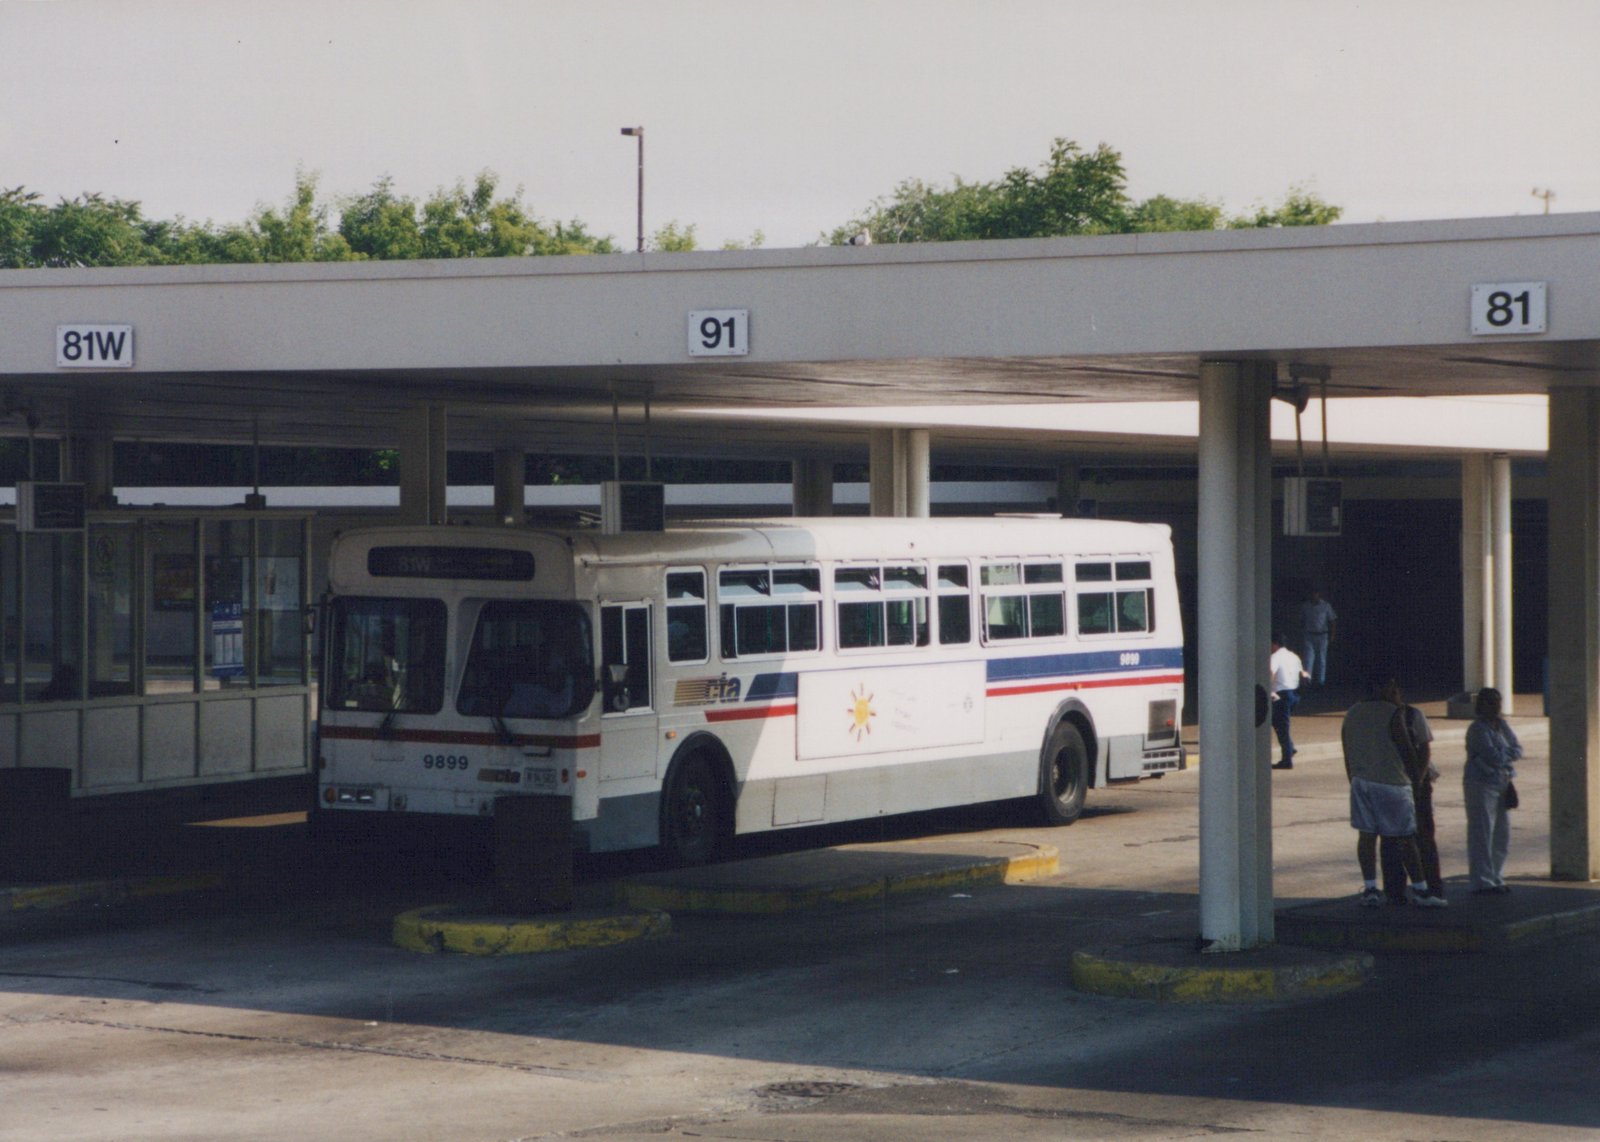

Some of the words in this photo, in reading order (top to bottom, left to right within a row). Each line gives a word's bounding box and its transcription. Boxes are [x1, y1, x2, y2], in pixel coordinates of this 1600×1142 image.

[1486, 291, 1530, 327] 81
[62, 330, 126, 361] 81W
[700, 316, 735, 349] 91
[705, 671, 742, 703] cta
[423, 753, 469, 771] 9899
